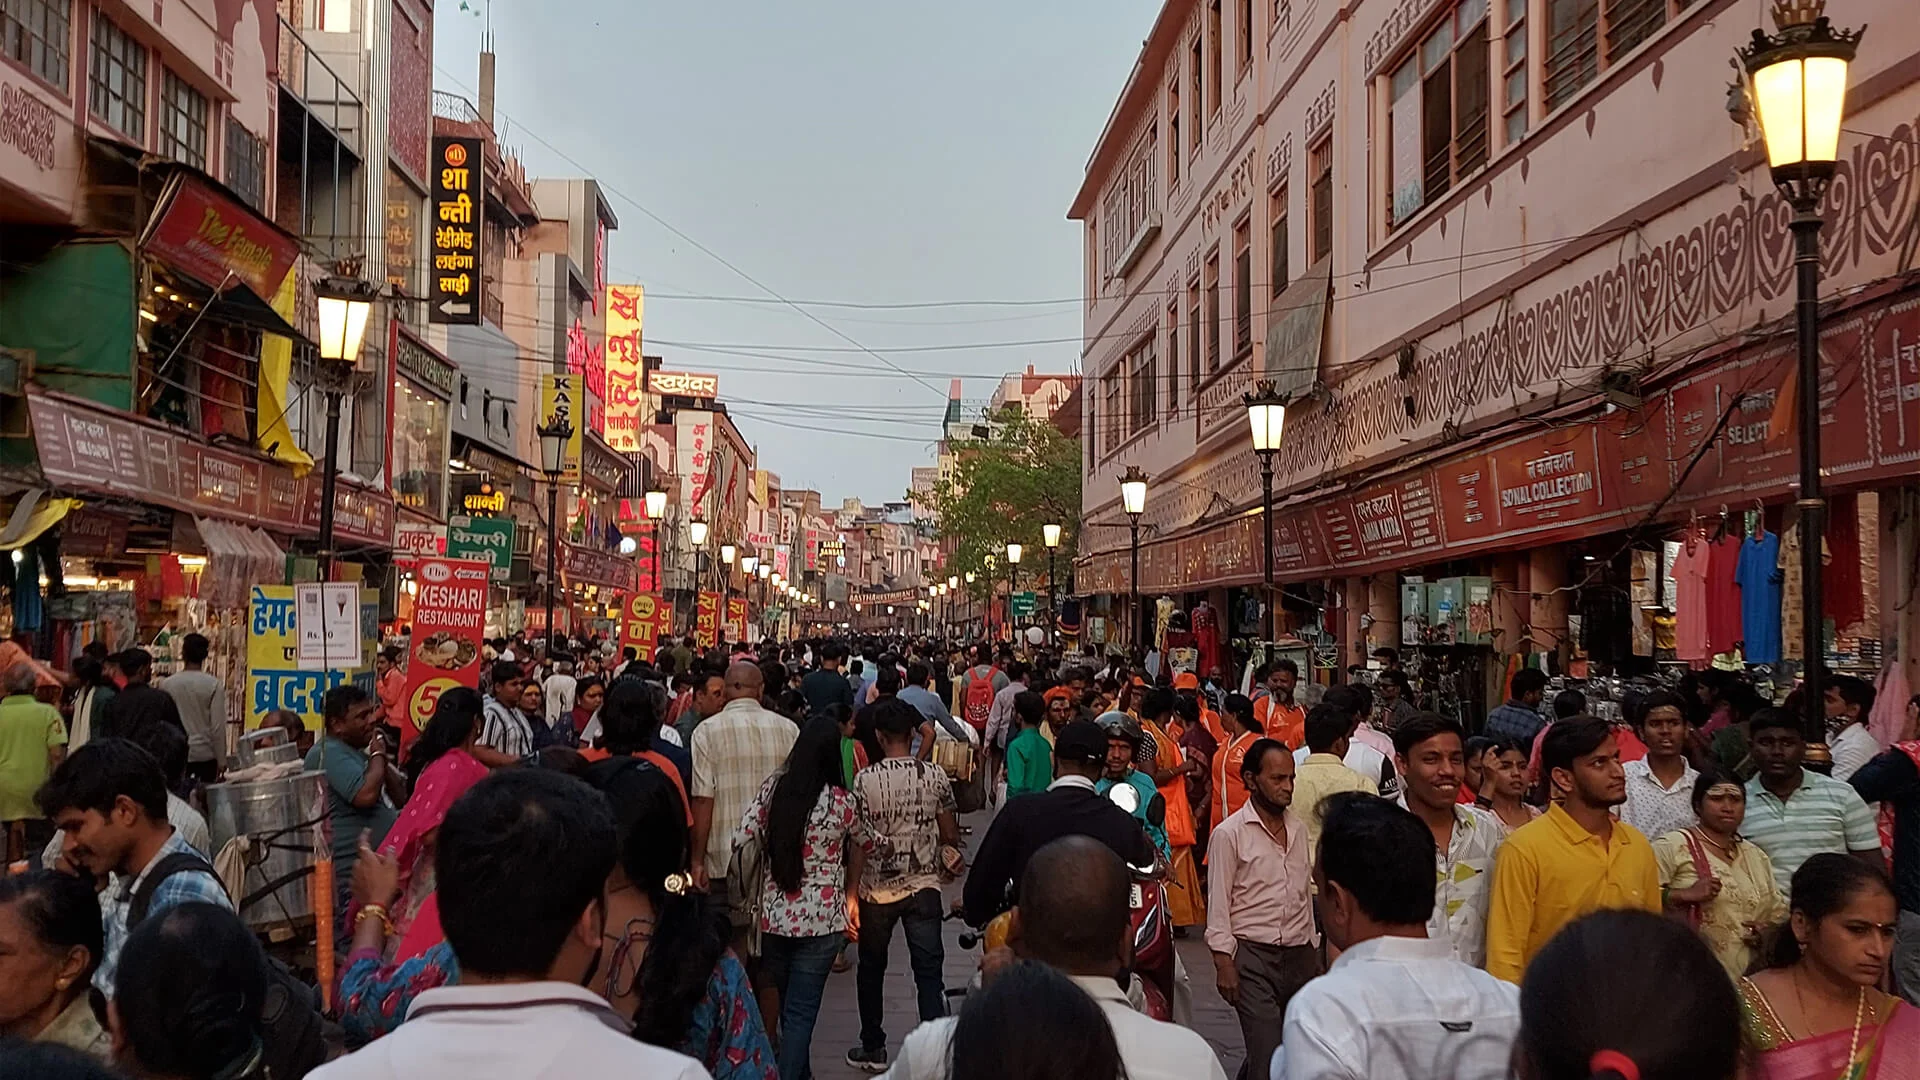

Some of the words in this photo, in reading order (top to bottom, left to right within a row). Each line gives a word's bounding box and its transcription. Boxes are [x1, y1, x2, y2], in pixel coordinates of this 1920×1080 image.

[224, 225, 273, 271] Female
[436, 227, 473, 249] रेडीमेड
[436, 251, 473, 270] लहंगा
[650, 372, 717, 394] स्वयंवर
[1502, 485, 1532, 508] SONAL
[1531, 471, 1593, 501] COLLECTION
[464, 490, 505, 512] शान्ती
[418, 584, 483, 611] KESHARI
[416, 608, 481, 629] RESTAURANT
[306, 631, 320, 640] Rs.
